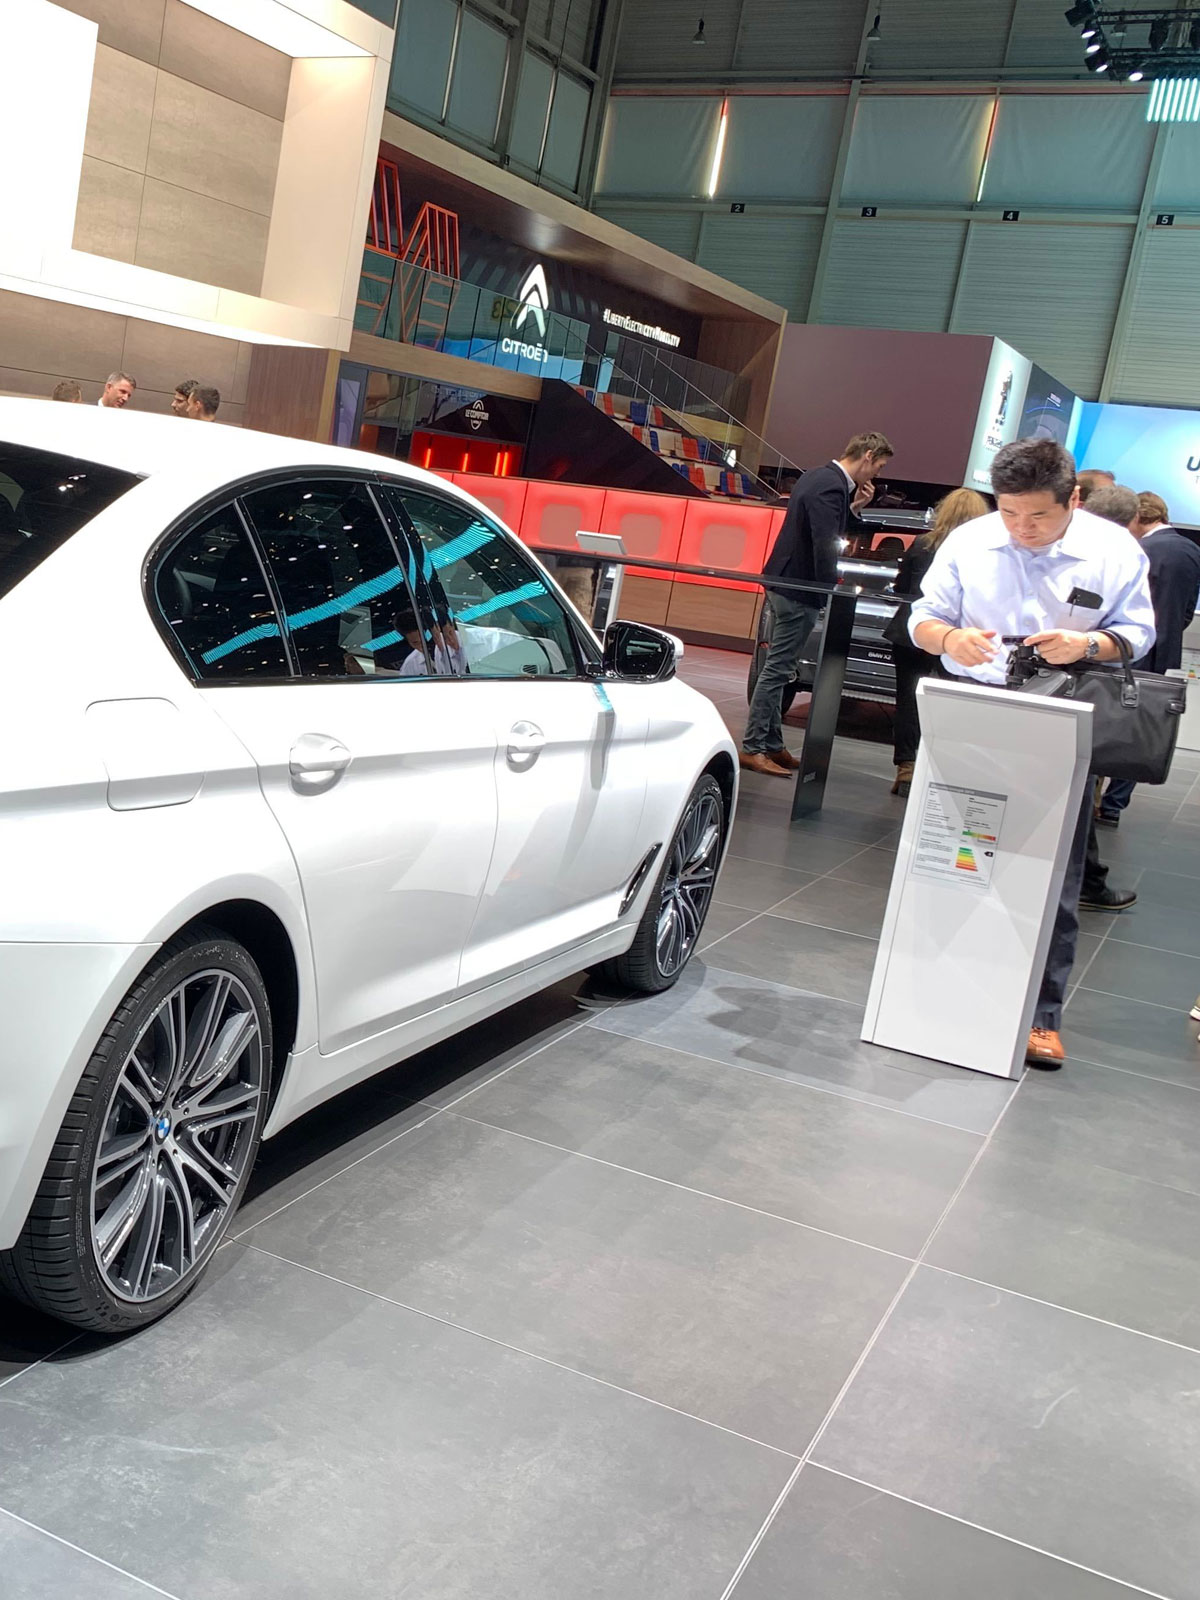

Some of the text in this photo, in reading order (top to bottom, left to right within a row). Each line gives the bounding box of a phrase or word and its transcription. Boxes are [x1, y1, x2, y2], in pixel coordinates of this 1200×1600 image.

[865, 208, 872, 217] 3
[1006, 211, 1014, 221] 4
[1161, 216, 1169, 225] 5
